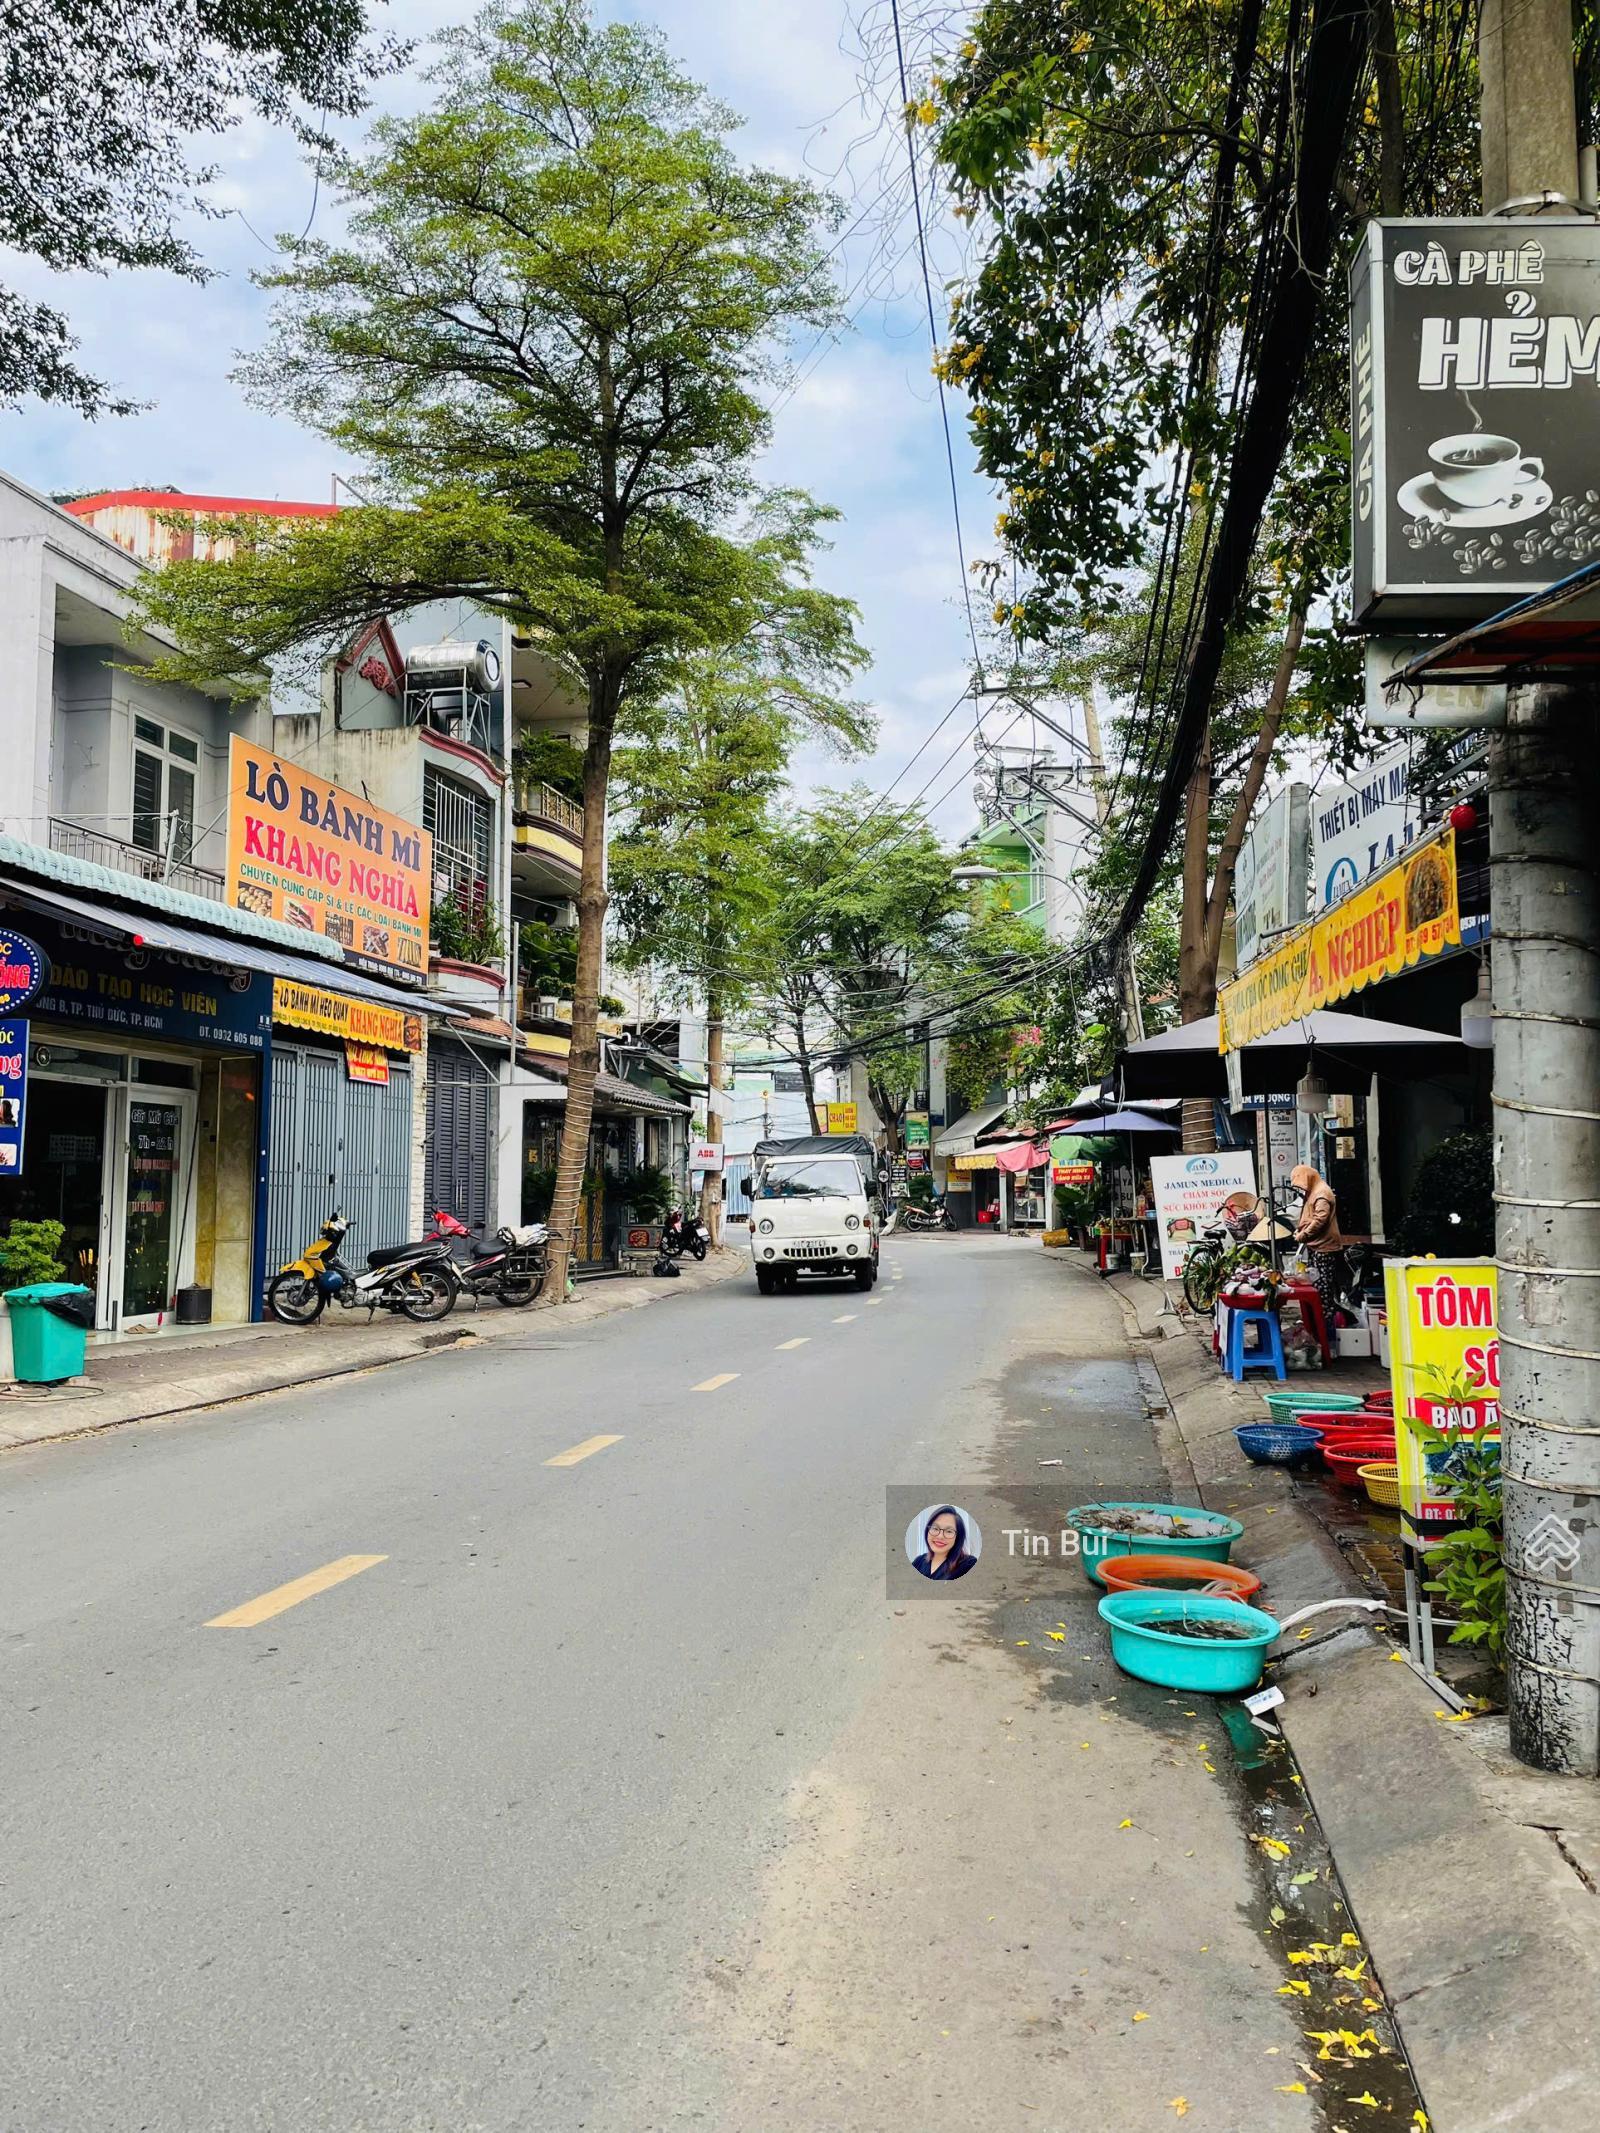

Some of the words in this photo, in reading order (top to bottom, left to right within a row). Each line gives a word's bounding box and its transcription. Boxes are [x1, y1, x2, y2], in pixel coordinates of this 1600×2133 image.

[1393, 240, 1452, 286] CÀ
[1457, 239, 1545, 285] PHÊ
[1418, 290, 1600, 390] HẺM
[245, 760, 290, 811] LÒ
[299, 786, 384, 856] BÁNH
[391, 830, 421, 872] MÌ
[1319, 796, 1346, 843] THIẾT
[1348, 795, 1361, 829] BỊ
[1362, 774, 1386, 818] MÁY
[244, 815, 342, 887] KHANG
[349, 858, 420, 918] NGHĨA
[1328, 887, 1400, 986] NGHIỆP
[350, 1007, 378, 1038] KHANG
[1164, 1180, 1198, 1190] JAMUN
[1200, 1177, 1245, 1187] MEDICAL
[1416, 1276, 1492, 1327] TÔM
